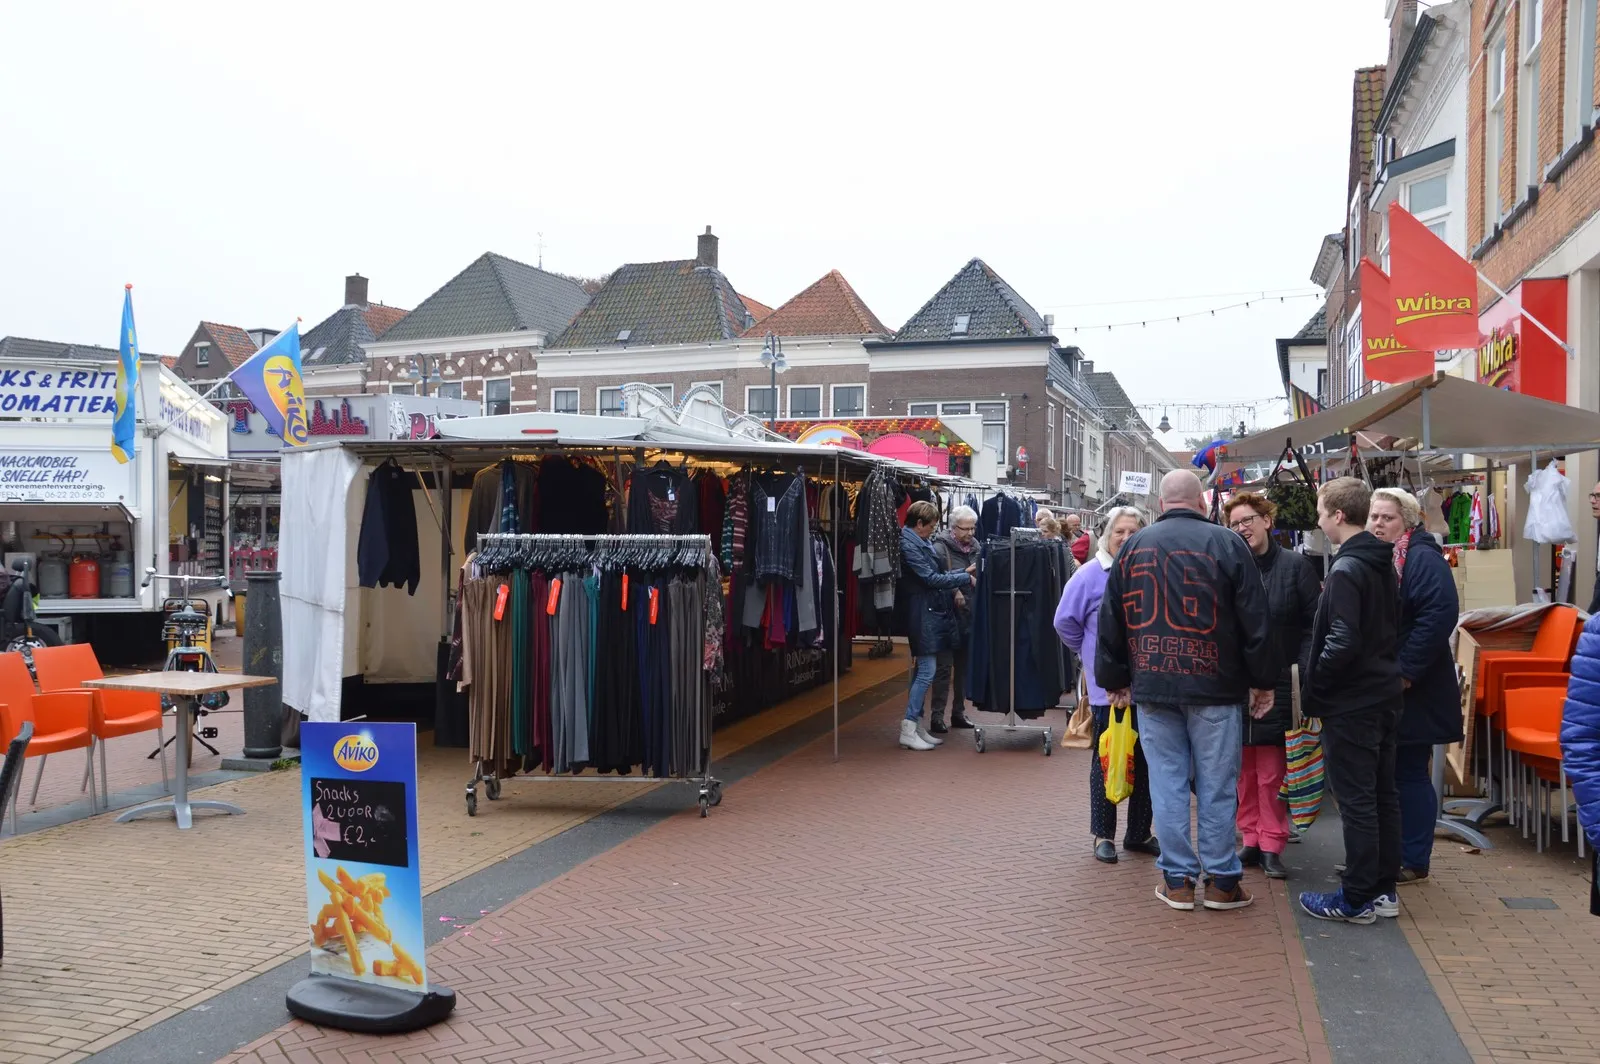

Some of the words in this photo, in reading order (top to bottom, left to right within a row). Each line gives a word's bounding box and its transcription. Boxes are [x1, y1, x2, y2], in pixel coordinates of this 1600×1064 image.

[1396, 292, 1471, 312] Wibra
[1479, 327, 1513, 378] Wibra
[0, 369, 37, 388] KS
[38, 373, 52, 388] &
[0, 393, 119, 413] OMATIEK
[1, 469, 52, 483] SNELLE
[52, 469, 89, 482] HAP!
[1119, 547, 1218, 635] 56
[1127, 634, 1218, 659] SCCER
[337, 740, 376, 763] Aviko
[315, 780, 359, 804] Snacks
[326, 804, 335, 820] 2
